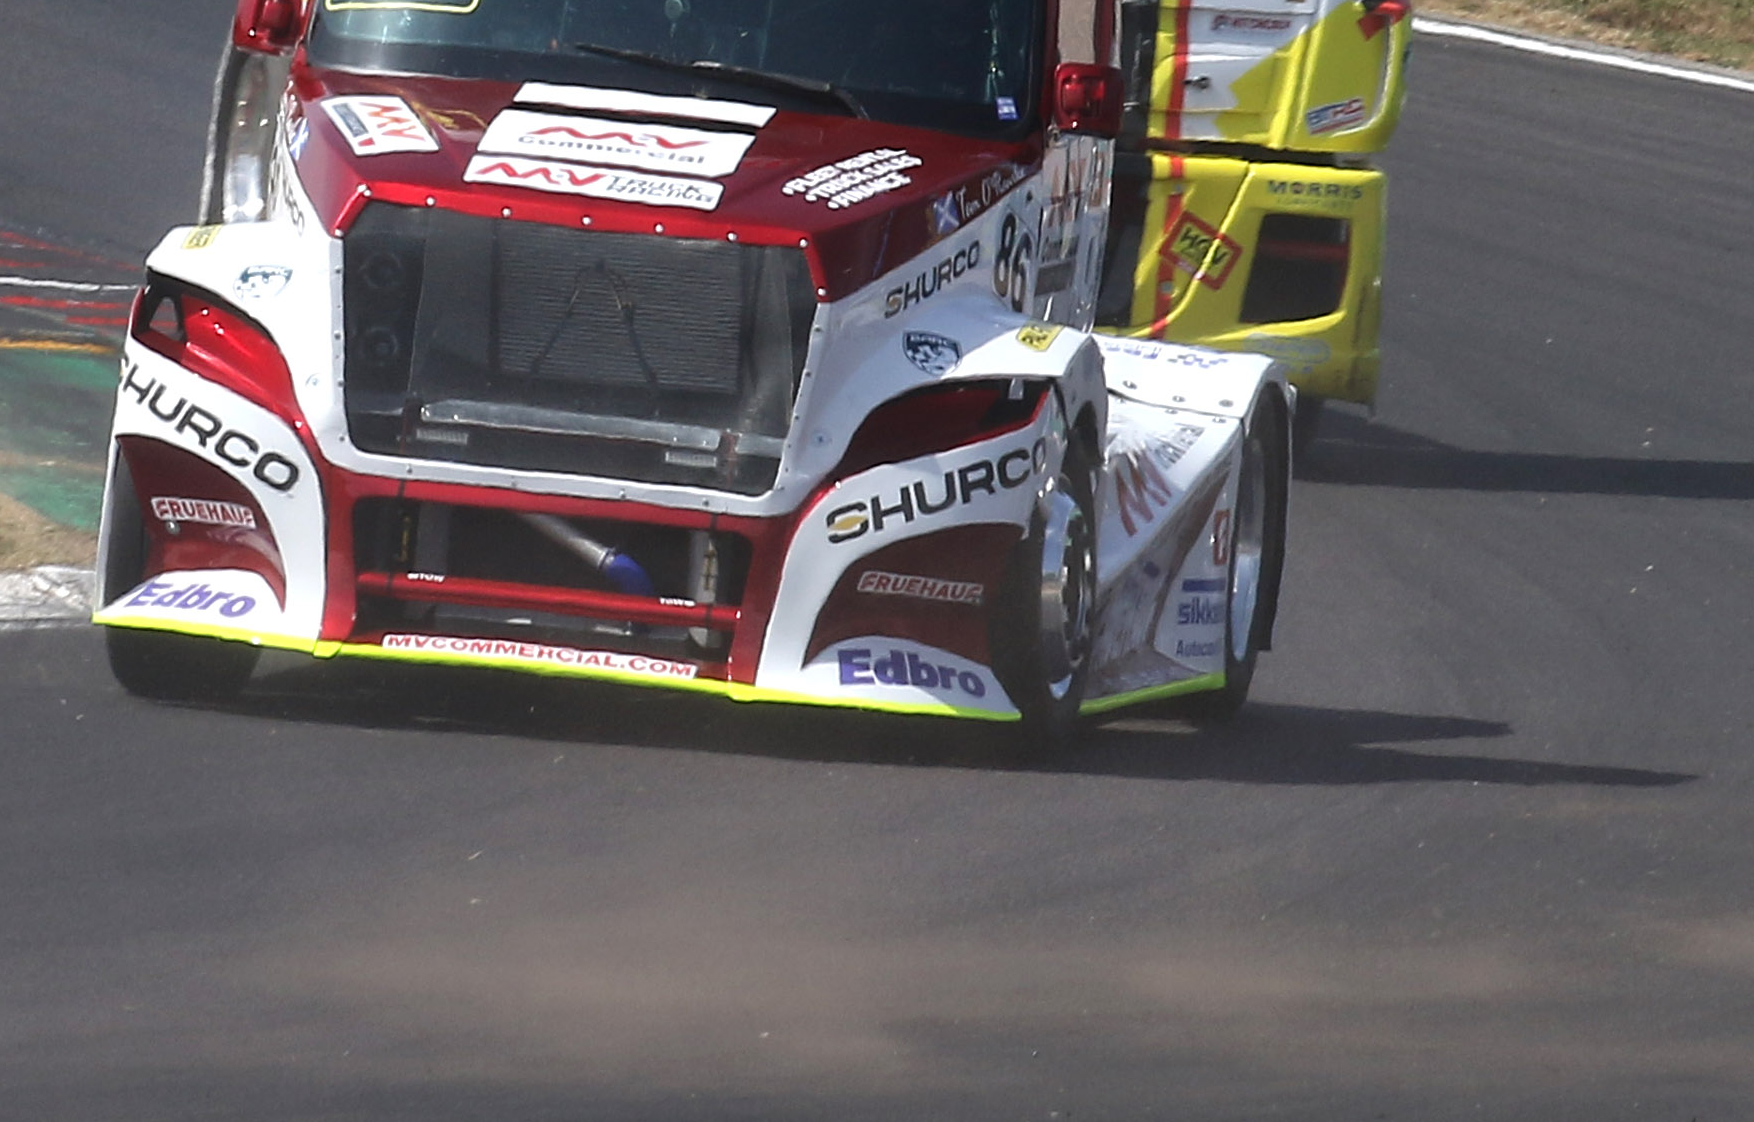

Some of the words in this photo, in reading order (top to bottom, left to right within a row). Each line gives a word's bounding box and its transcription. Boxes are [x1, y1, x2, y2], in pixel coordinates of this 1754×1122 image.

[1266, 179, 1363, 200] MORRIS
[884, 240, 981, 319] SHURCO
[994, 212, 1033, 314] 86
[826, 436, 1047, 544] SHURCO
[129, 580, 256, 617] Edbro
[387, 634, 694, 678] MVCOMMERCIAL.COM
[837, 648, 987, 699] Edbro
